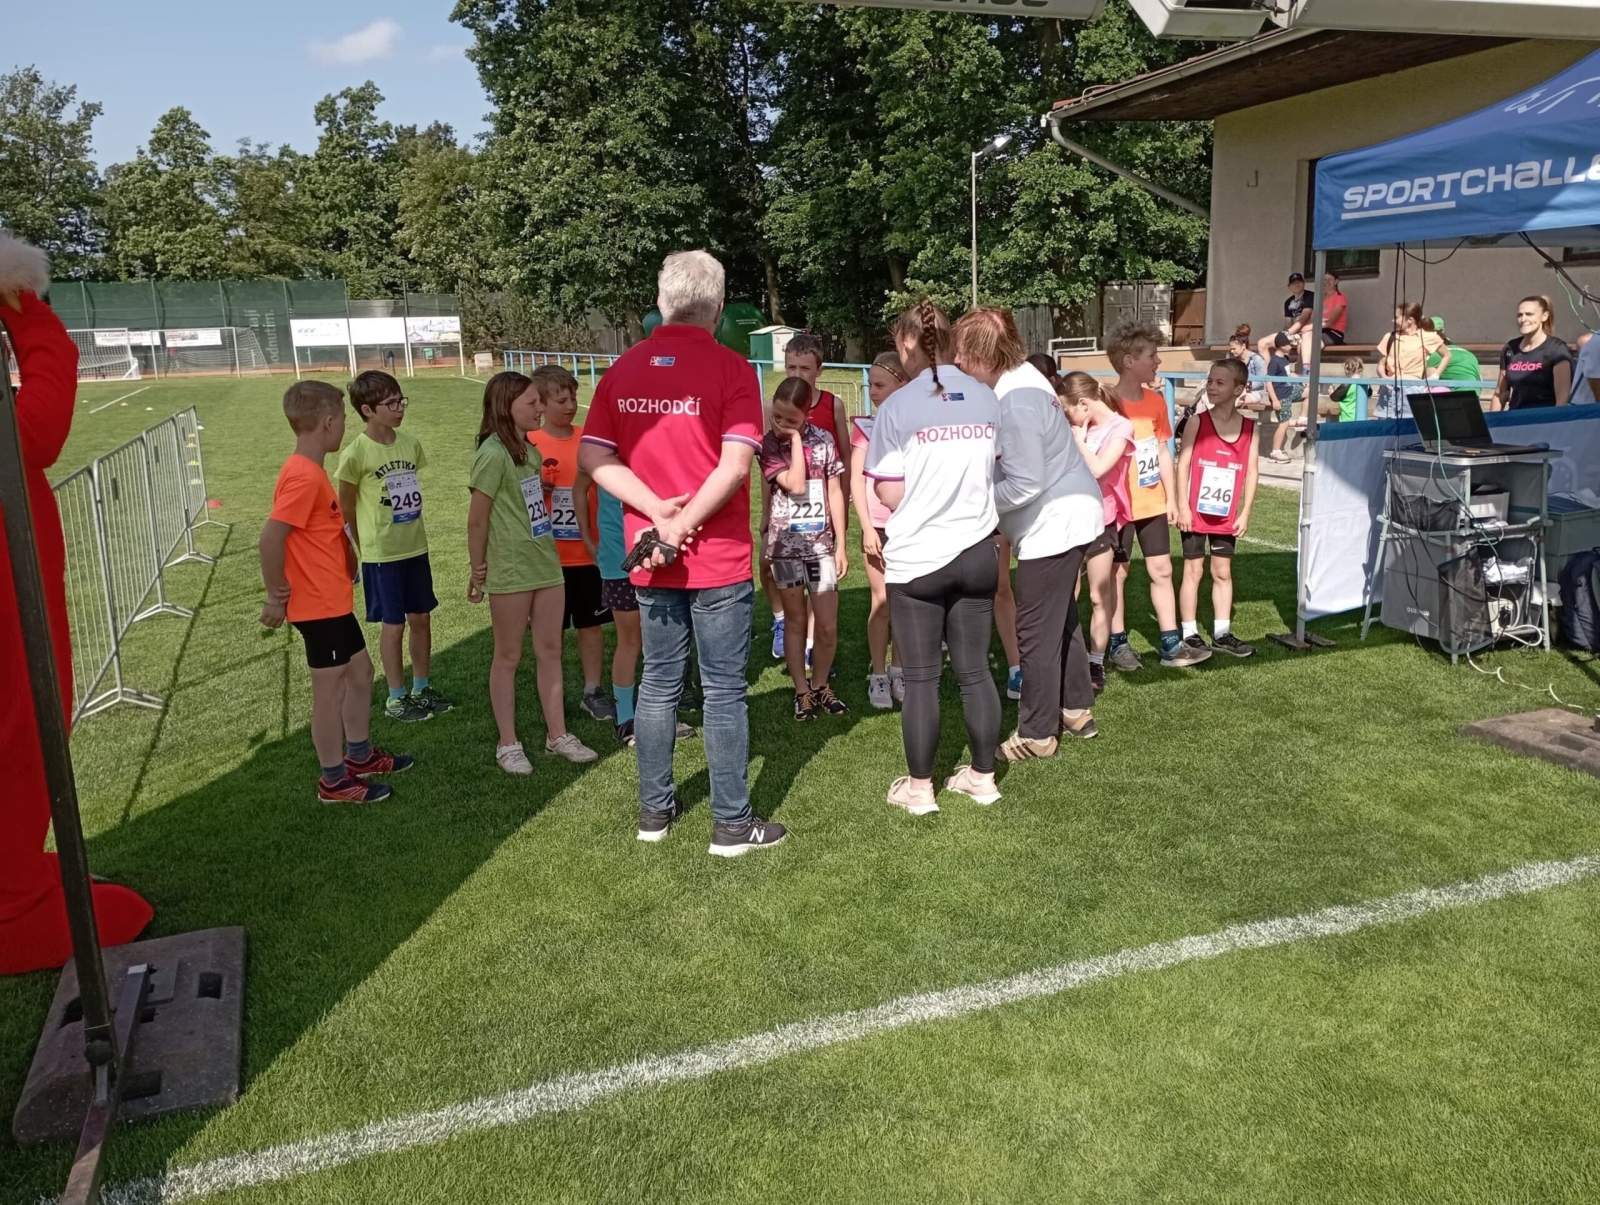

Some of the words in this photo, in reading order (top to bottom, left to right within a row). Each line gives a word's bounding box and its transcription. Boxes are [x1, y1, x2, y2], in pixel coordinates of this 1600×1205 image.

[1508, 361, 1543, 372] adidas
[617, 396, 701, 416] ROZHODČÍ
[916, 421, 995, 445] ROZHODČÍ
[1138, 454, 1160, 475] 244
[391, 490, 422, 511] 249
[1200, 486, 1232, 504] 246
[528, 499, 548, 522] 232
[552, 509, 577, 526] 22
[791, 502, 824, 520] 222
